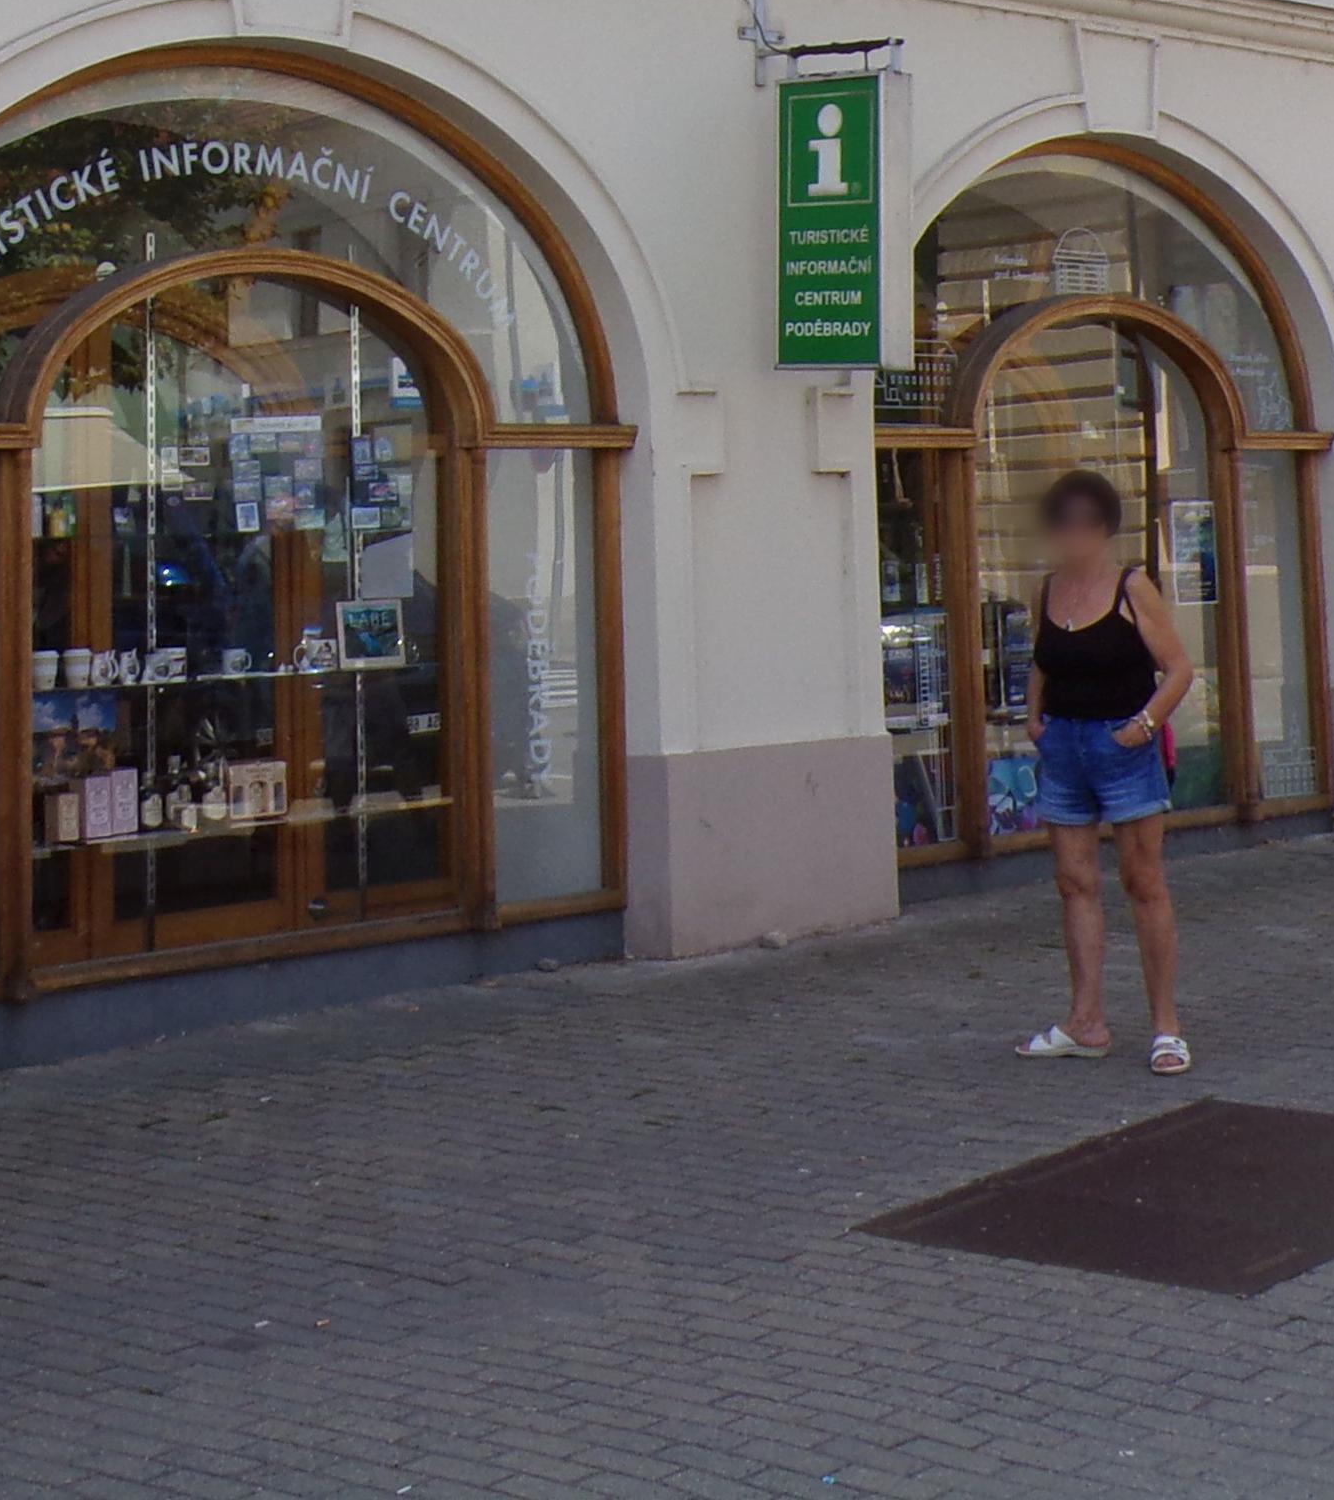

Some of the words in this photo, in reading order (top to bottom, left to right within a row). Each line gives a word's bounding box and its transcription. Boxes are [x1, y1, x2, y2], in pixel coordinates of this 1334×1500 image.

[138, 140, 376, 204] INFORMAČNÍ
[387, 190, 516, 333] CENTRUM
[789, 223, 870, 245] TURISTICKÉ
[786, 255, 872, 276] INFORMAČNÍ
[794, 290, 862, 306] CENTRUM
[785, 318, 871, 337] PODĚBRADY
